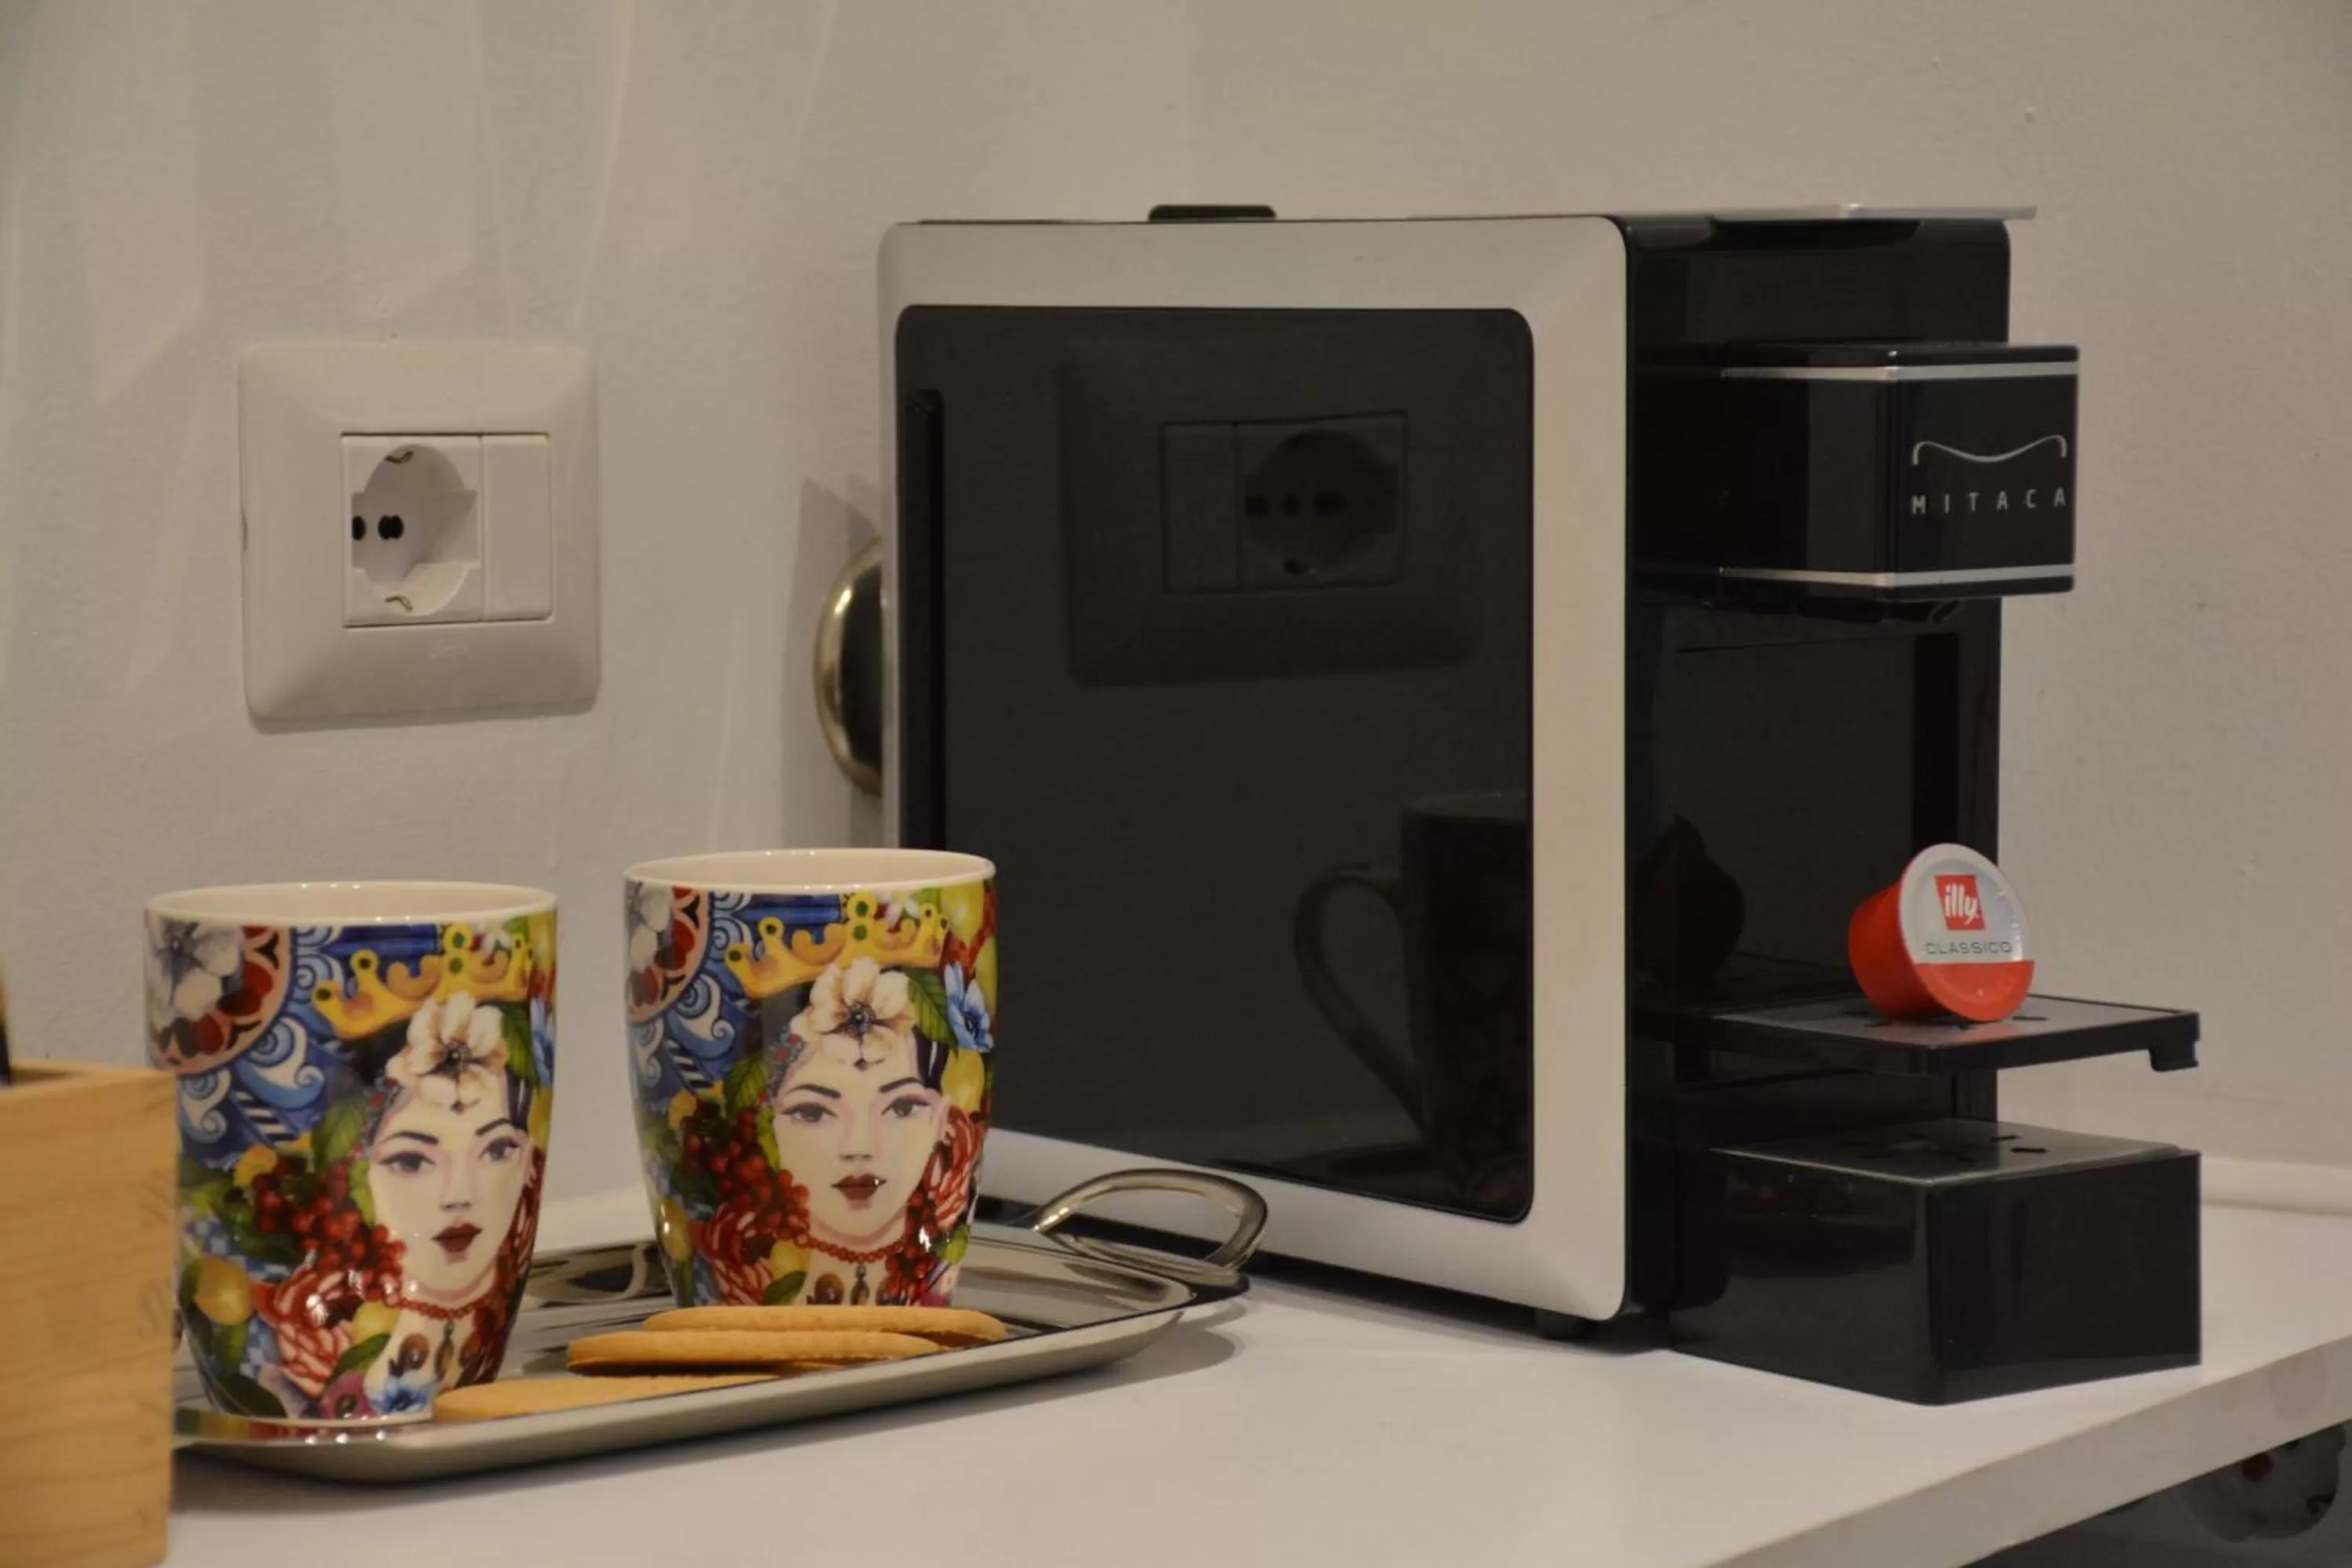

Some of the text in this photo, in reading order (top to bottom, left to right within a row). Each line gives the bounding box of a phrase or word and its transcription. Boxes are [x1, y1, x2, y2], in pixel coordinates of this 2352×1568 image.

[1911, 487, 2067, 514] MITACA
[1944, 882, 1980, 926] illy
[1926, 941, 2013, 954] CLASSICO
